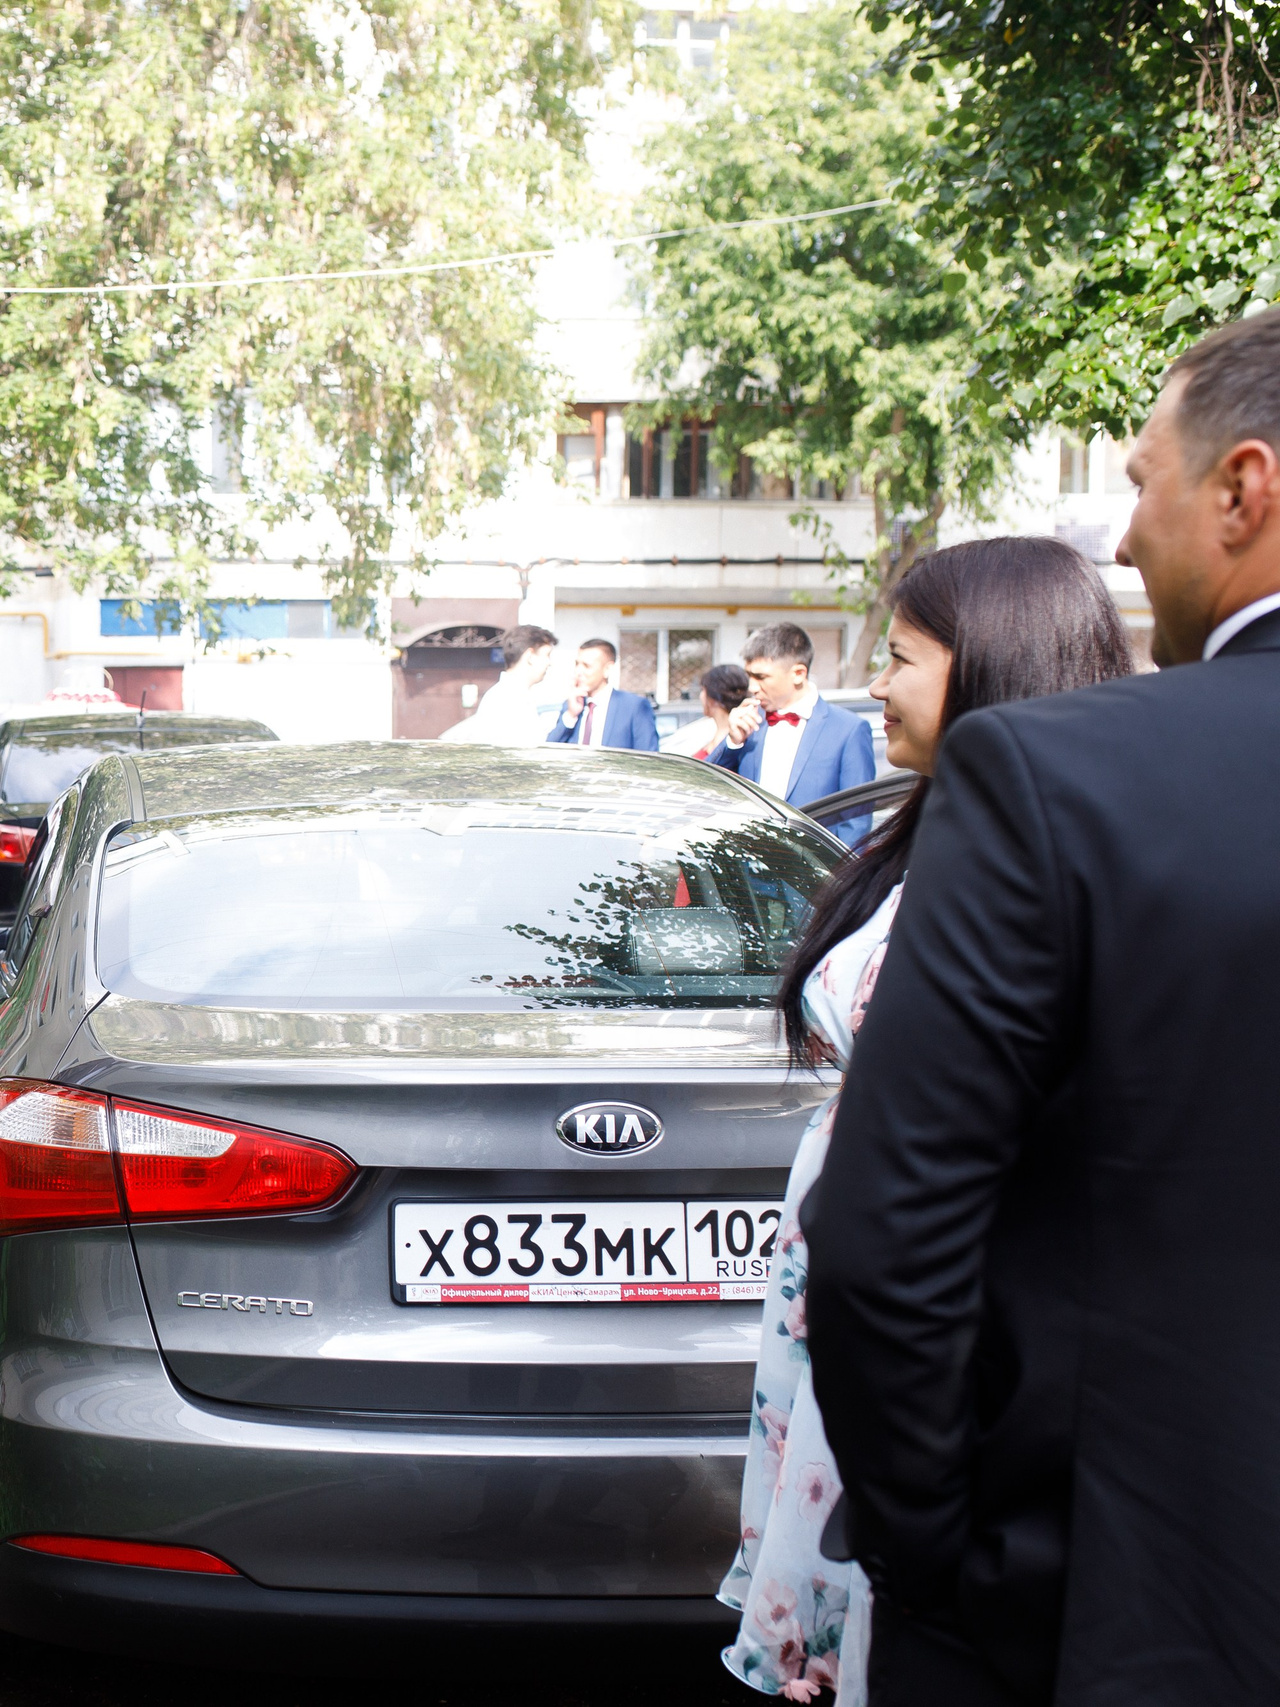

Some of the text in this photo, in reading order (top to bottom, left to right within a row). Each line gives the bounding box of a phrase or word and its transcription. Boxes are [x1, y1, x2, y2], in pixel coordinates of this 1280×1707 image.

[575, 1114, 646, 1143] KIA
[419, 1209, 782, 1277] Х833МК 102
[717, 1260, 763, 1277] RUS
[441, 1287, 529, 1298] Официальный дилер
[623, 1287, 636, 1297] ул.
[732, 1285, 754, 1295] (846)
[177, 1291, 314, 1316] CERATO
